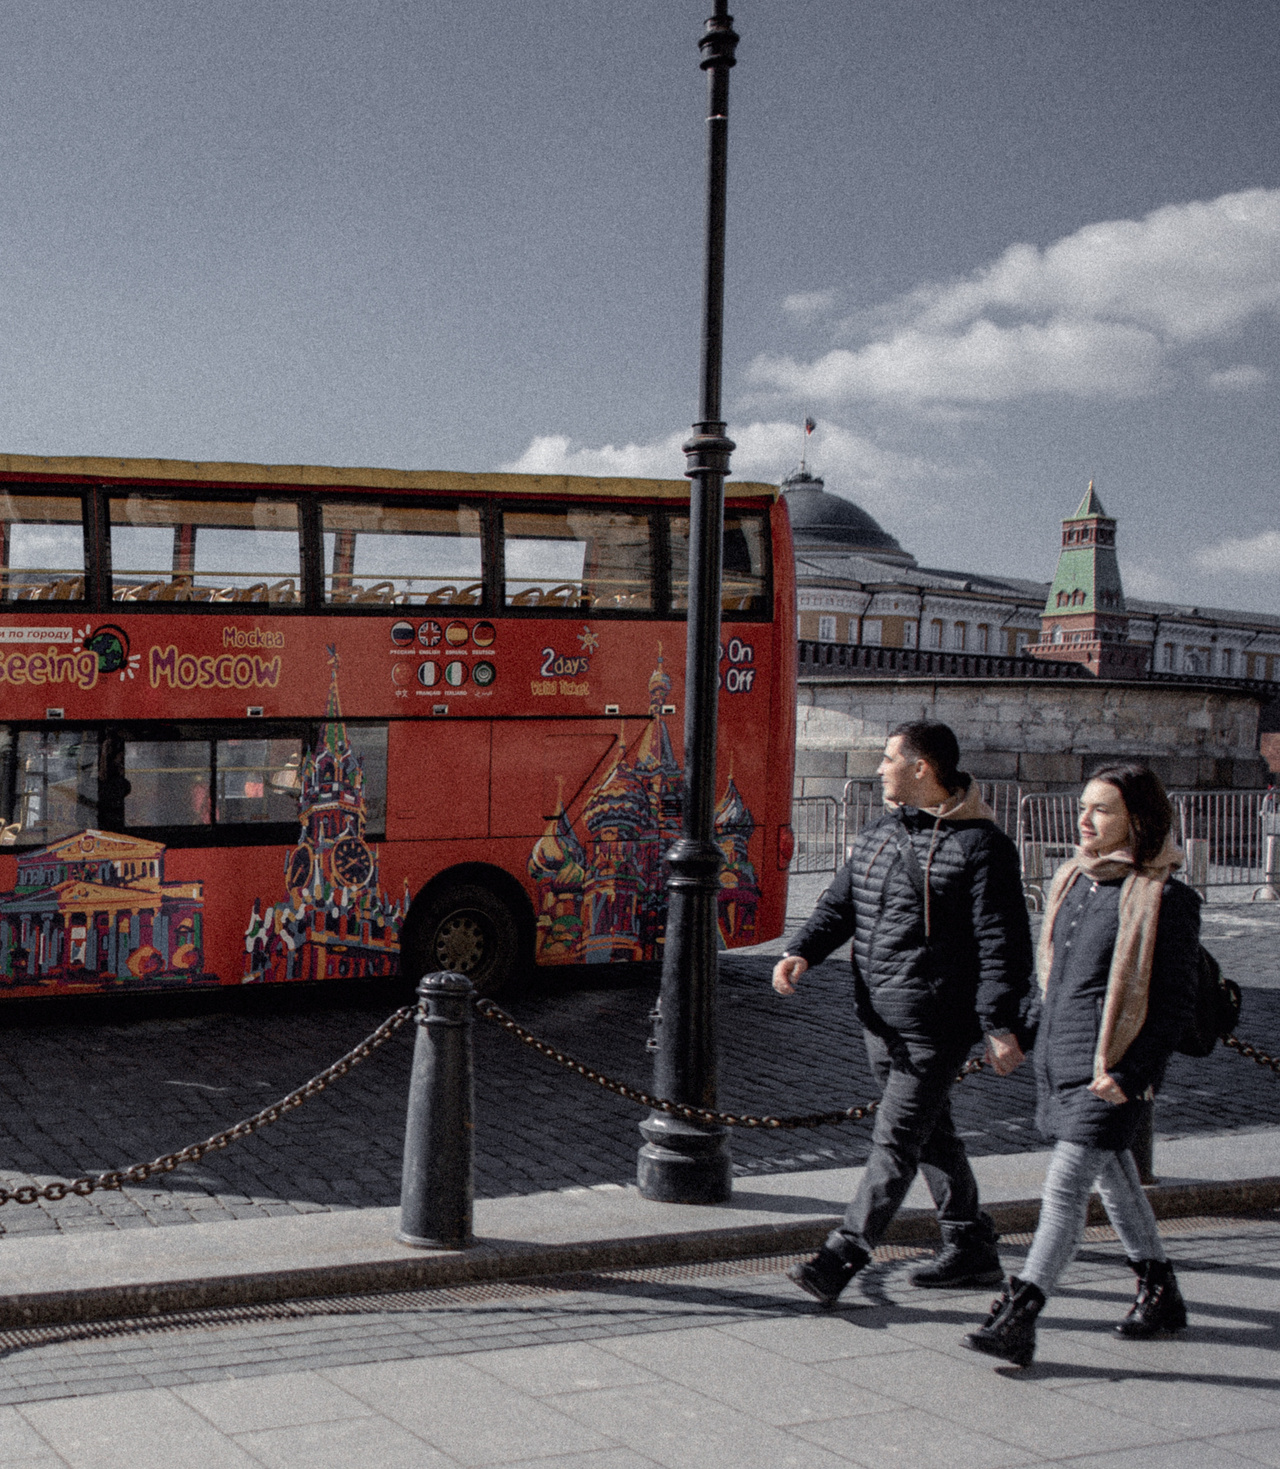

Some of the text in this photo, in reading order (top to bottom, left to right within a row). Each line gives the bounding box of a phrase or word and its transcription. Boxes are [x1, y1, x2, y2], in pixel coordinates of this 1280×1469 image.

[8, 630, 24, 638] по
[27, 629, 70, 640] городу
[223, 626, 285, 649] Москва
[729, 639, 752, 662] On
[727, 668, 754, 692] Off
